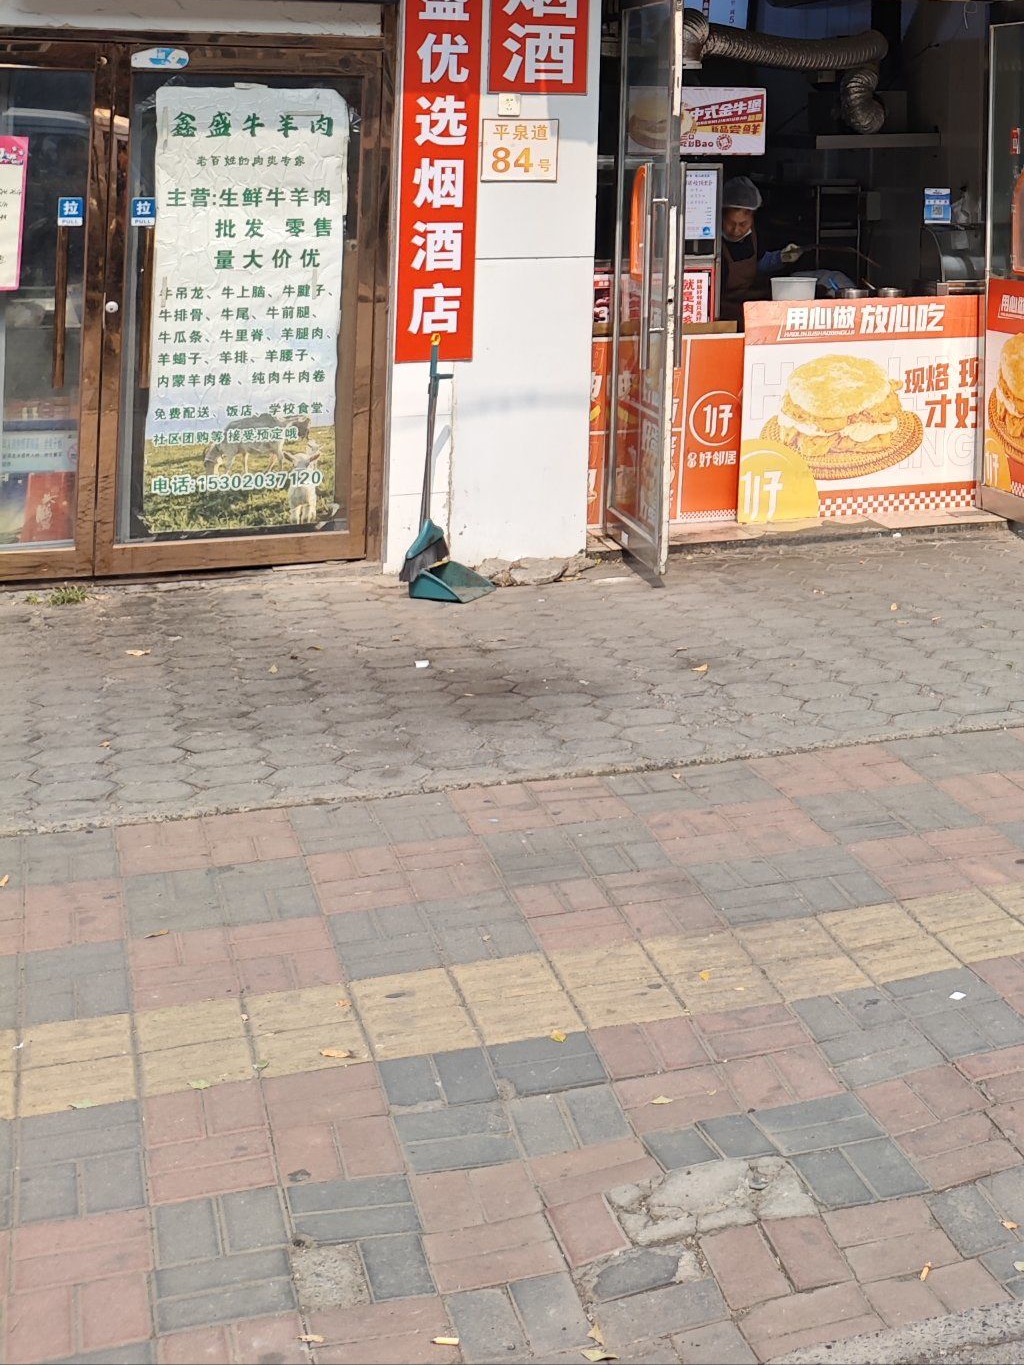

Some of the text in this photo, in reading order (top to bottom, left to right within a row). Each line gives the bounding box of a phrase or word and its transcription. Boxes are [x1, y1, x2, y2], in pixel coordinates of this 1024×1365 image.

[170, 110, 335, 138] 鑫盛牛羊肉
[493, 123, 549, 141] 平泉道
[196, 154, 306, 168] 老百姓的肉类专家
[63, 200, 79, 216] 拉
[136, 200, 152, 216] 拉
[215, 217, 333, 238] 批发 零售
[214, 248, 321, 270] 量大价优
[785, 303, 946, 334] 用心做 放心吃
[905, 362, 950, 393] 现烙
[699, 450, 737, 467] 好邻居
